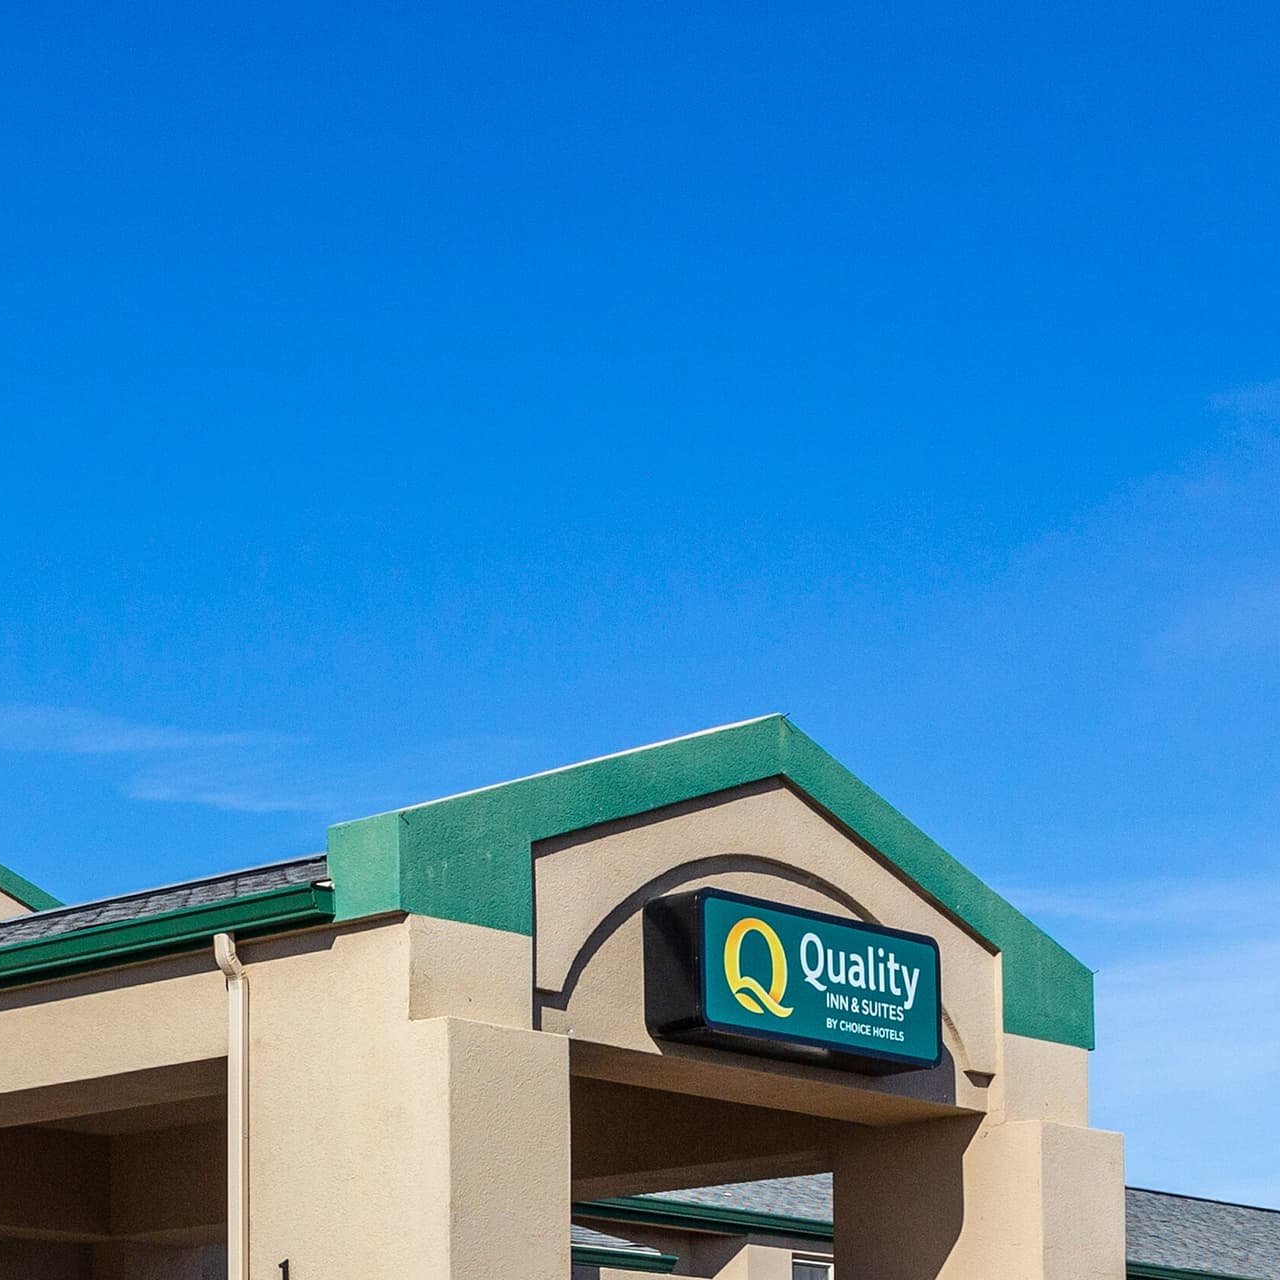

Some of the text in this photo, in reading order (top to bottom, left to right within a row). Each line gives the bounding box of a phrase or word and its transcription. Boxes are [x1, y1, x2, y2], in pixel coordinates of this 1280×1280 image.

[723, 917, 793, 1018] Q
[799, 932, 919, 1009] Quality
[826, 991, 904, 1021] INN & SUITES
[826, 1017, 905, 1042] BY CHOICE HOTELS
